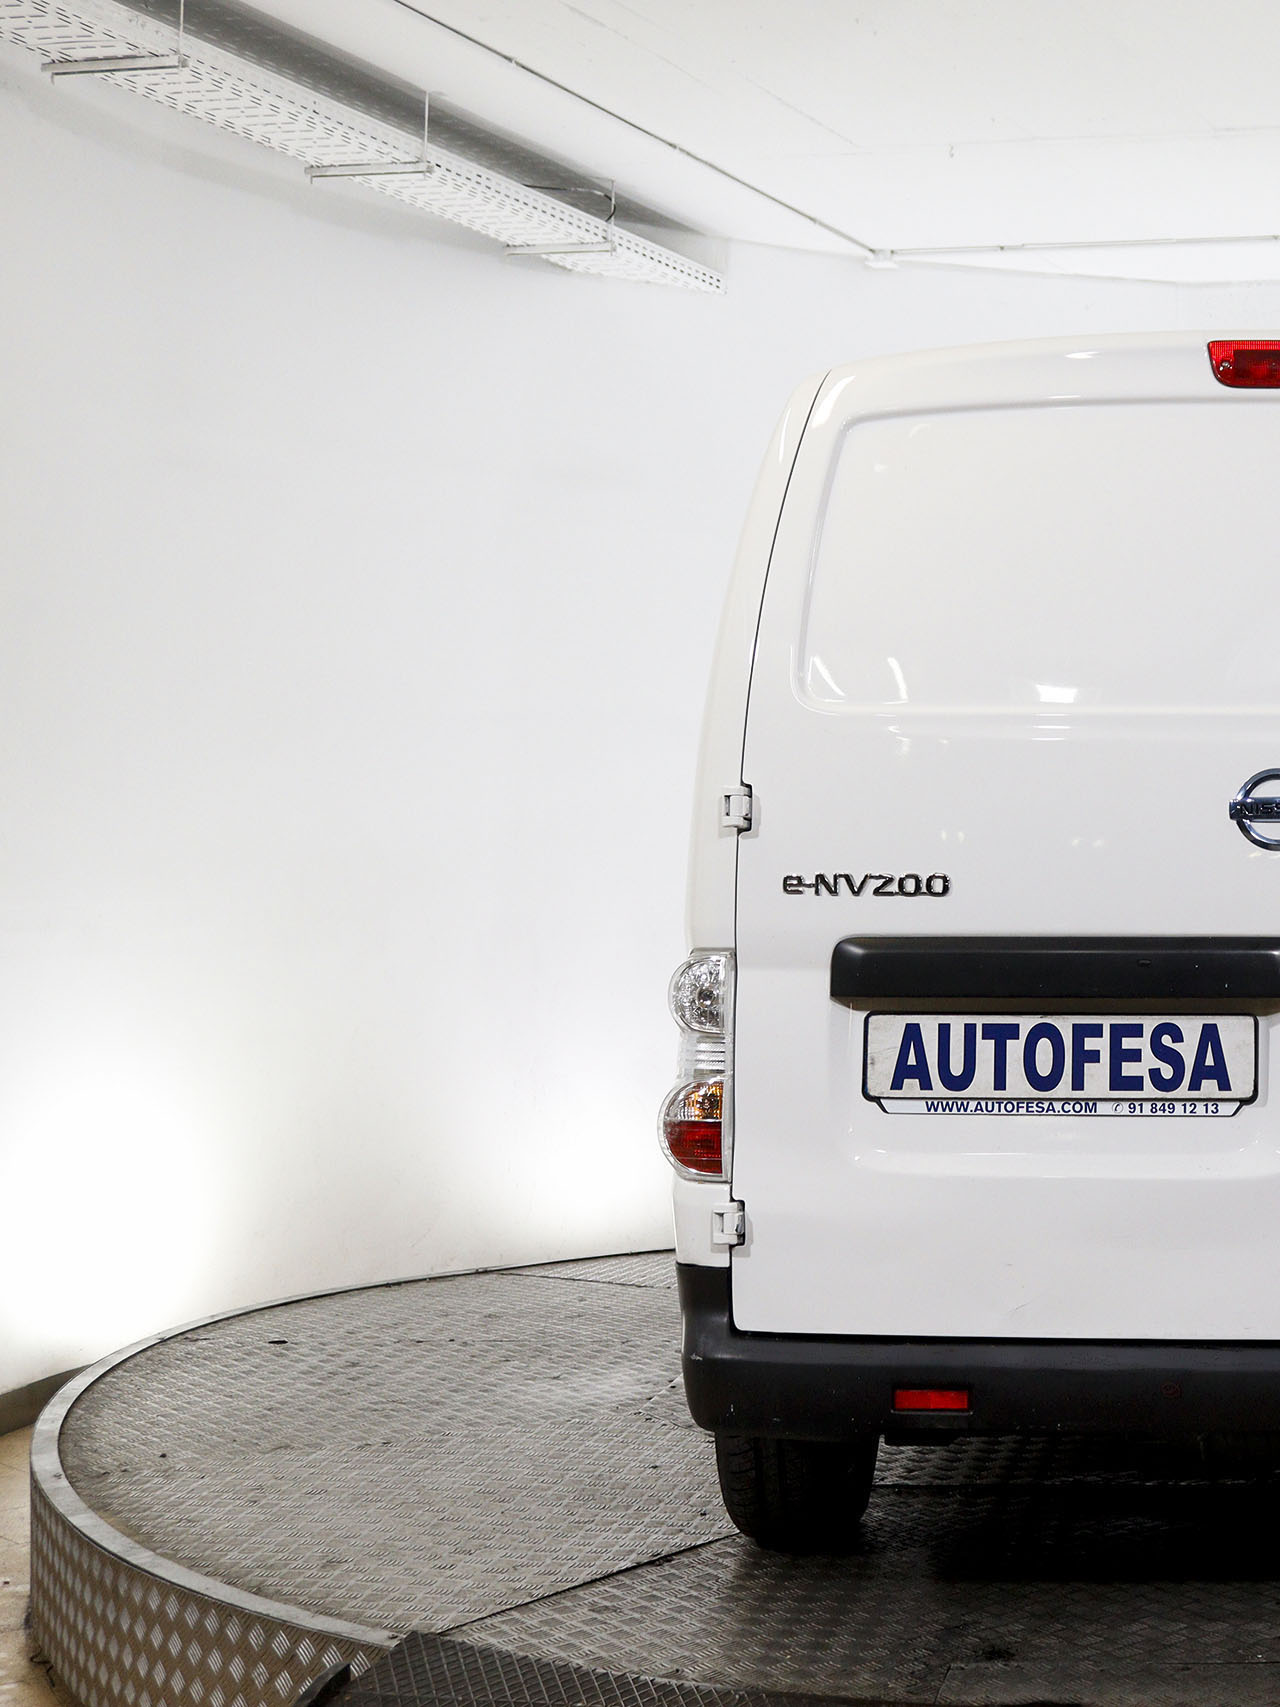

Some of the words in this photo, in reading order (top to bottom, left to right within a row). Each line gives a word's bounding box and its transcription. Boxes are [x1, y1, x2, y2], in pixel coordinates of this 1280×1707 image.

[782, 873, 952, 897] e-NV200
[890, 1022, 1232, 1092] AUTOFESA
[925, 1101, 1098, 1114] WWW.AUTOFESA.COM
[1128, 1102, 1144, 1114] 91
[1150, 1102, 1176, 1114] 849
[1182, 1102, 1197, 1114] 12
[1203, 1102, 1219, 1114] 13
